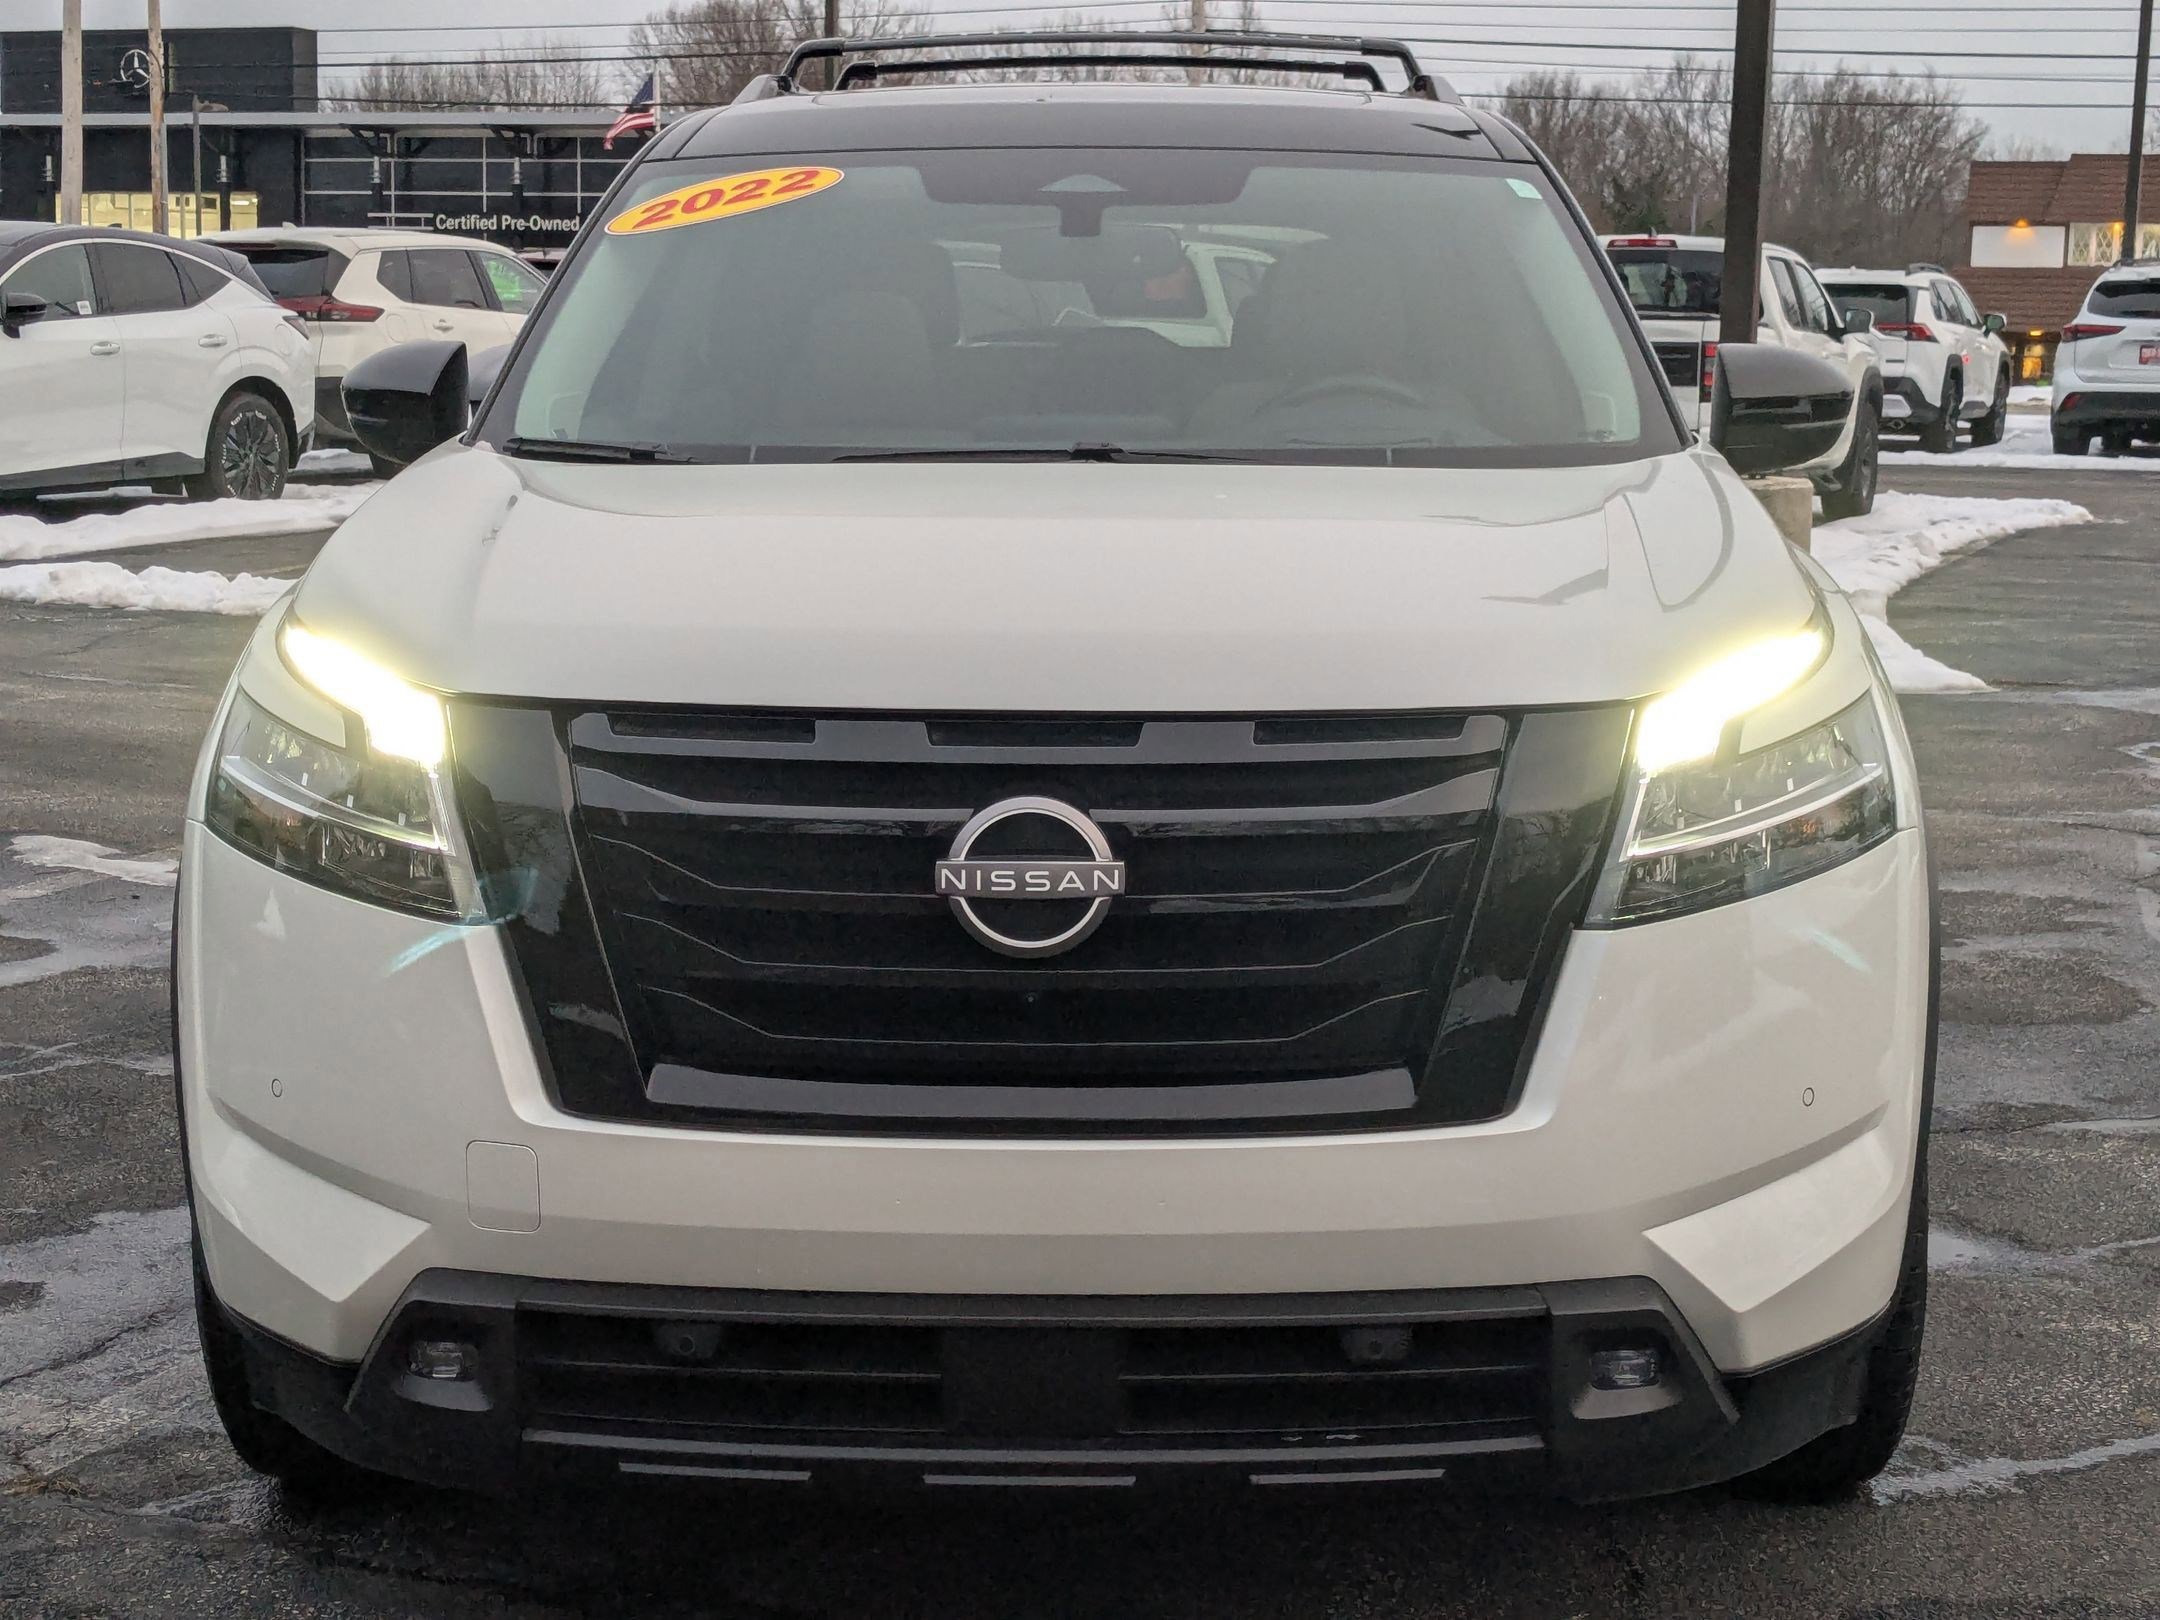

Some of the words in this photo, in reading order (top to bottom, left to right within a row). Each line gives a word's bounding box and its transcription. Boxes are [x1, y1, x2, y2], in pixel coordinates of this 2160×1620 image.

[632, 170, 820, 229] 2022
[436, 214, 497, 231] Certified
[501, 214, 580, 231] Pre-Owned
[941, 868, 1119, 892] NISSAN
